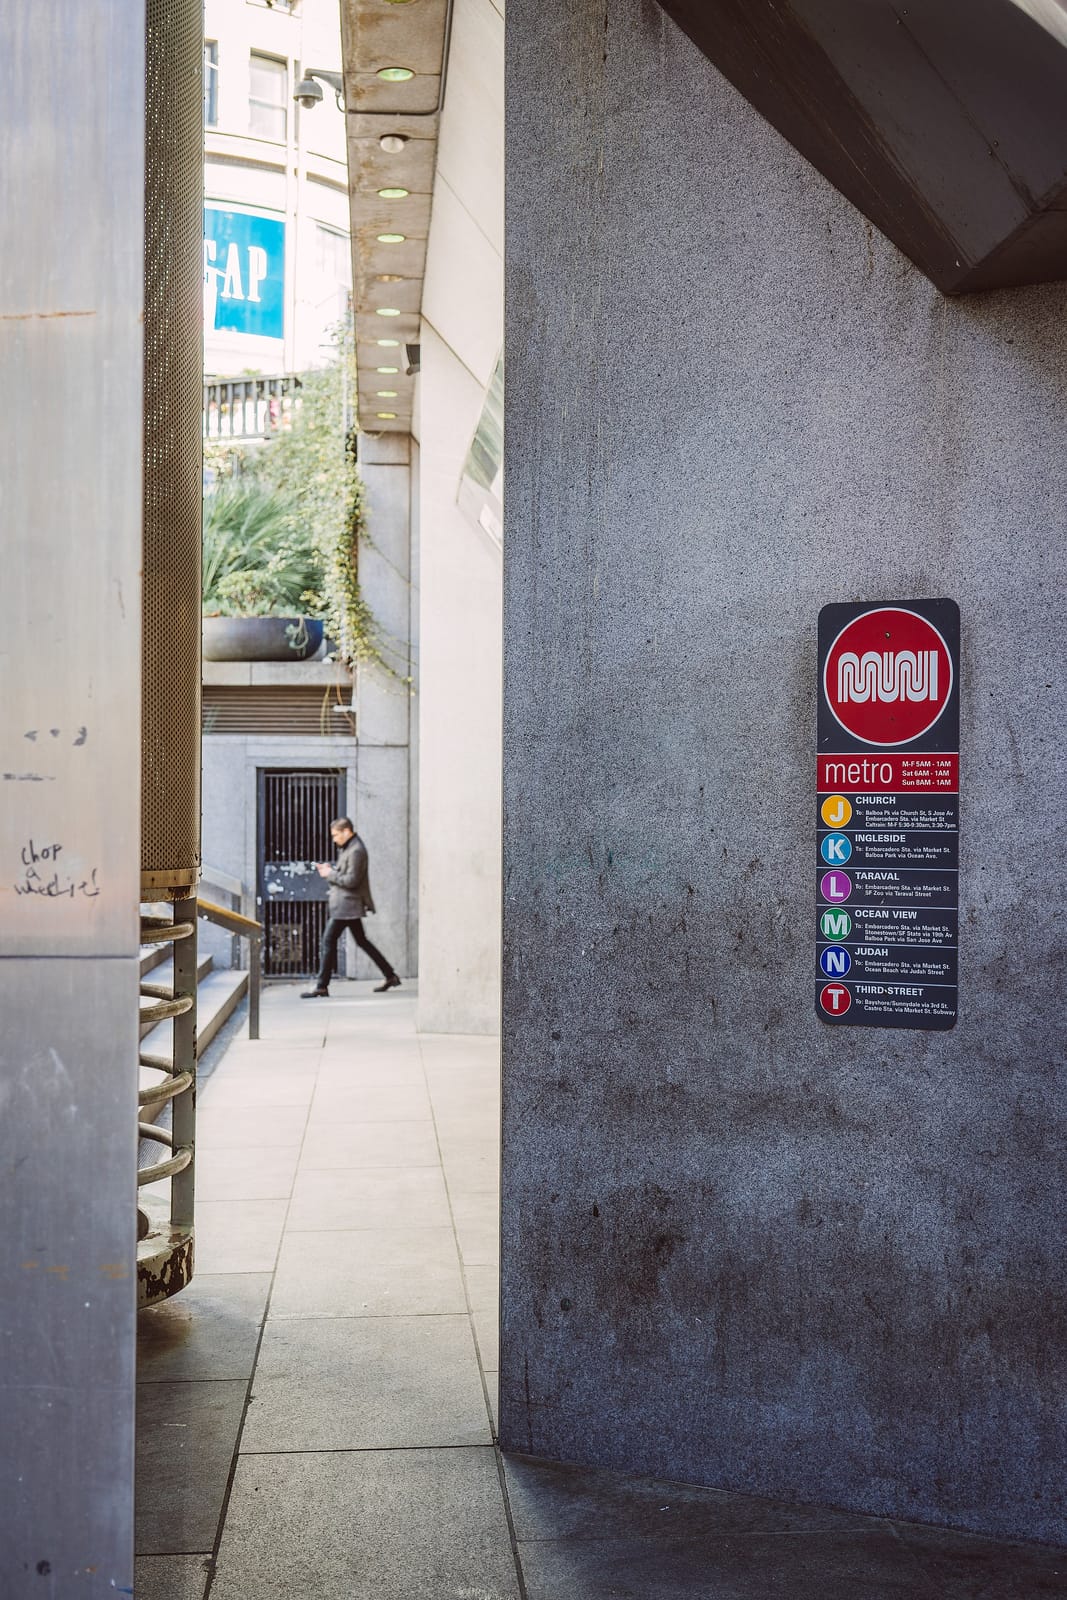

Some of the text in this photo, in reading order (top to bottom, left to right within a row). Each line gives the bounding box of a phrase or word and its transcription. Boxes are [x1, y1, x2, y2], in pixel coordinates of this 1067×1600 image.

[825, 759, 893, 784] metro
[829, 801, 844, 822] J
[828, 839, 845, 859] K
[855, 872, 899, 880] TARAVAL
[830, 877, 843, 897] L
[824, 914, 847, 935] M
[855, 910, 917, 919] OCEAN VIEW
[855, 948, 888, 956] JUDAH
[827, 952, 845, 973] N
[828, 989, 844, 1009] T
[855, 986, 924, 996] THIRD STREET
